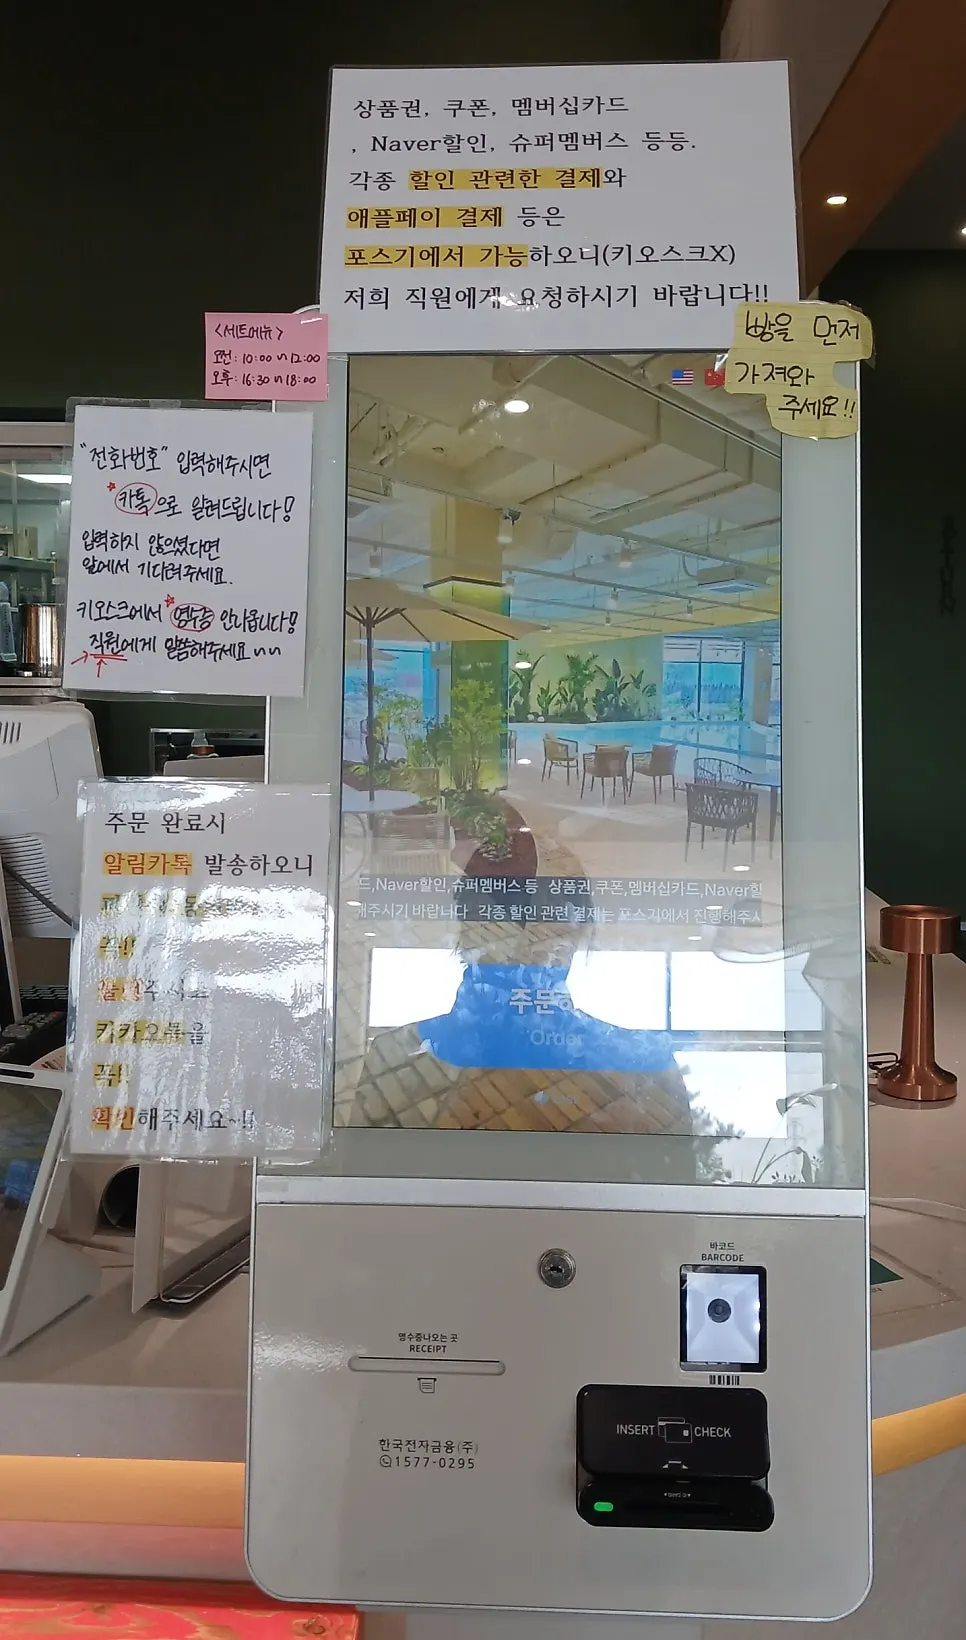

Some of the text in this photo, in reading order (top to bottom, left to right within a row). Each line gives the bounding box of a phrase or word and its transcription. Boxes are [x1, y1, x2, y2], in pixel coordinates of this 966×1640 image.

[353, 95, 630, 119] 상품권, 쿠폰, 멤버십카드
[370, 133, 496, 154] Naver할인,
[509, 131, 629, 152] 슈퍼멤버스
[641, 131, 697, 151] 등등.
[349, 167, 627, 191] 각종 할인 관련한 결제와
[347, 206, 565, 229] 애플페이 결제 등은
[345, 243, 736, 268] 포스기에서 가능하오니(키오스크X)
[344, 284, 769, 310] 저희 직원에게 요청하시기 바랍니다!!
[745, 310, 859, 346] 빵을 먼저
[735, 362, 815, 387] 가져와
[778, 395, 856, 420] 주세요!!
[177, 450, 272, 479] 입력해주시면
[191, 496, 296, 522] 알려드립니다!
[82, 530, 220, 561] 입력하지 않으셨다면
[82, 556, 233, 585] 앞에서 기다려주세요.
[76, 600, 162, 622] 키오스크에서
[173, 605, 214, 629] 영수증
[89, 631, 156, 654] 직원에게
[105, 812, 226, 835] 주문 완료시
[104, 854, 313, 877] 알림카톡 발송하오니
[525, 879, 538, 894] 등
[413, 904, 468, 919] 바랍니다
[478, 905, 506, 919] 각종
[510, 905, 537, 920] 할인
[541, 905, 569, 921] 관련
[574, 906, 614, 922] 결제는
[619, 907, 689, 924] 포스기에서
[530, 1029, 584, 1046] Order
[701, 1253, 745, 1262] BARCODE
[709, 1242, 735, 1251] 바코드
[409, 1345, 447, 1353] RECEIPT
[450, 1333, 459, 1343] 곳
[616, 1424, 732, 1438] INSERT CHECK
[378, 1438, 479, 1455] 한국전자금융(주)
[396, 1456, 475, 1469] 1577-0295
